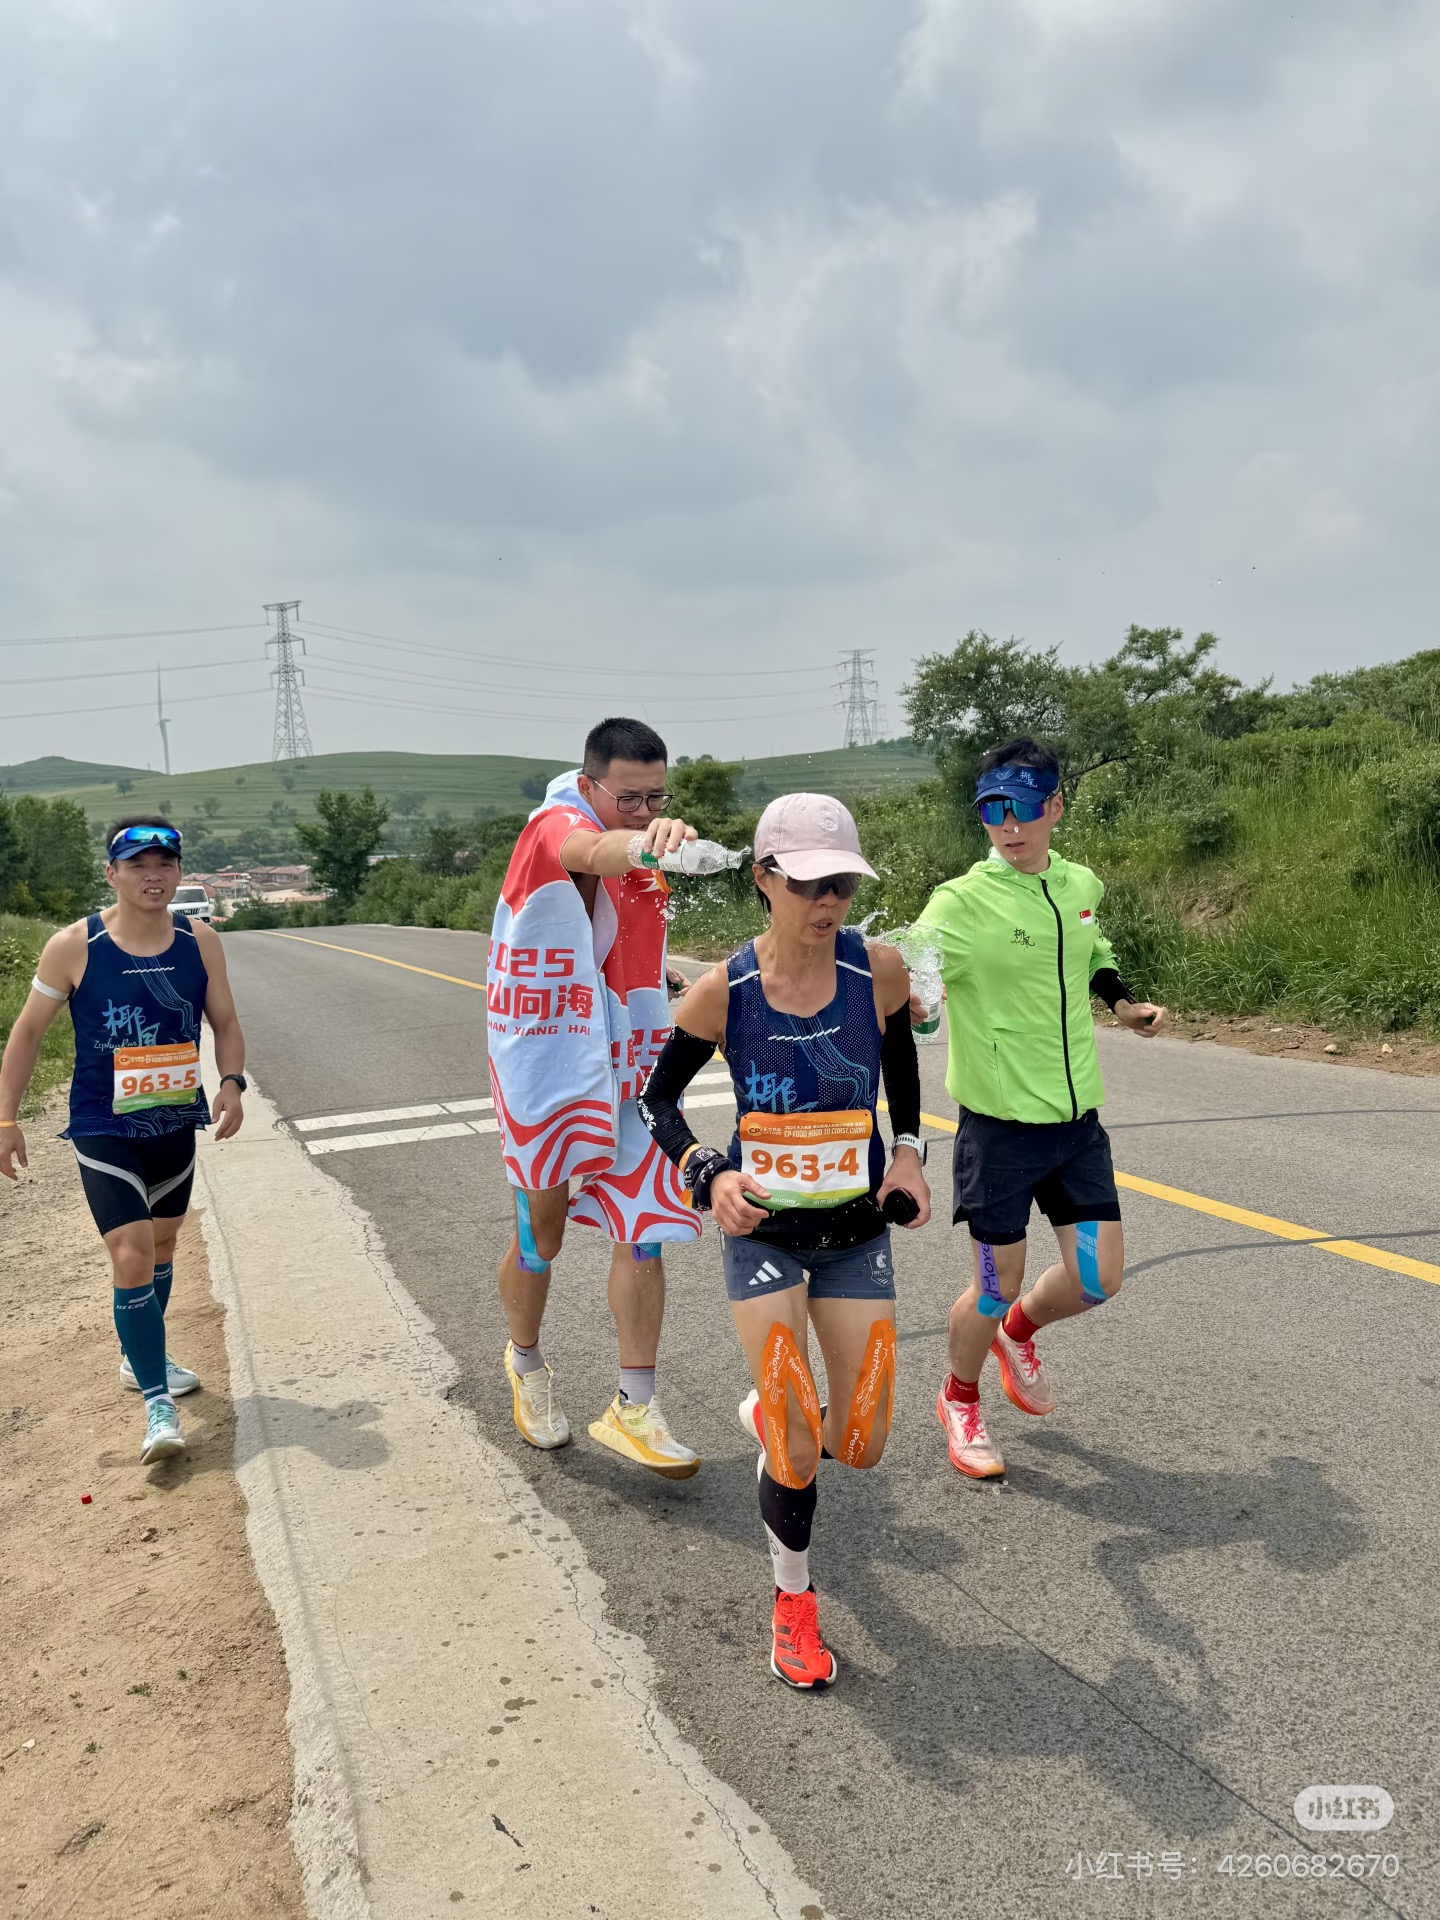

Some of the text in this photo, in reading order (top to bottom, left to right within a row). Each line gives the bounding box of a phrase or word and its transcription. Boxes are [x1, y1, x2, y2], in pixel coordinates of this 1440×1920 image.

[514, 1025, 559, 1037] XIANG
[568, 1024, 590, 1036] HAI
[121, 1069, 197, 1097] 963-5
[751, 1148, 859, 1182] 963-4
